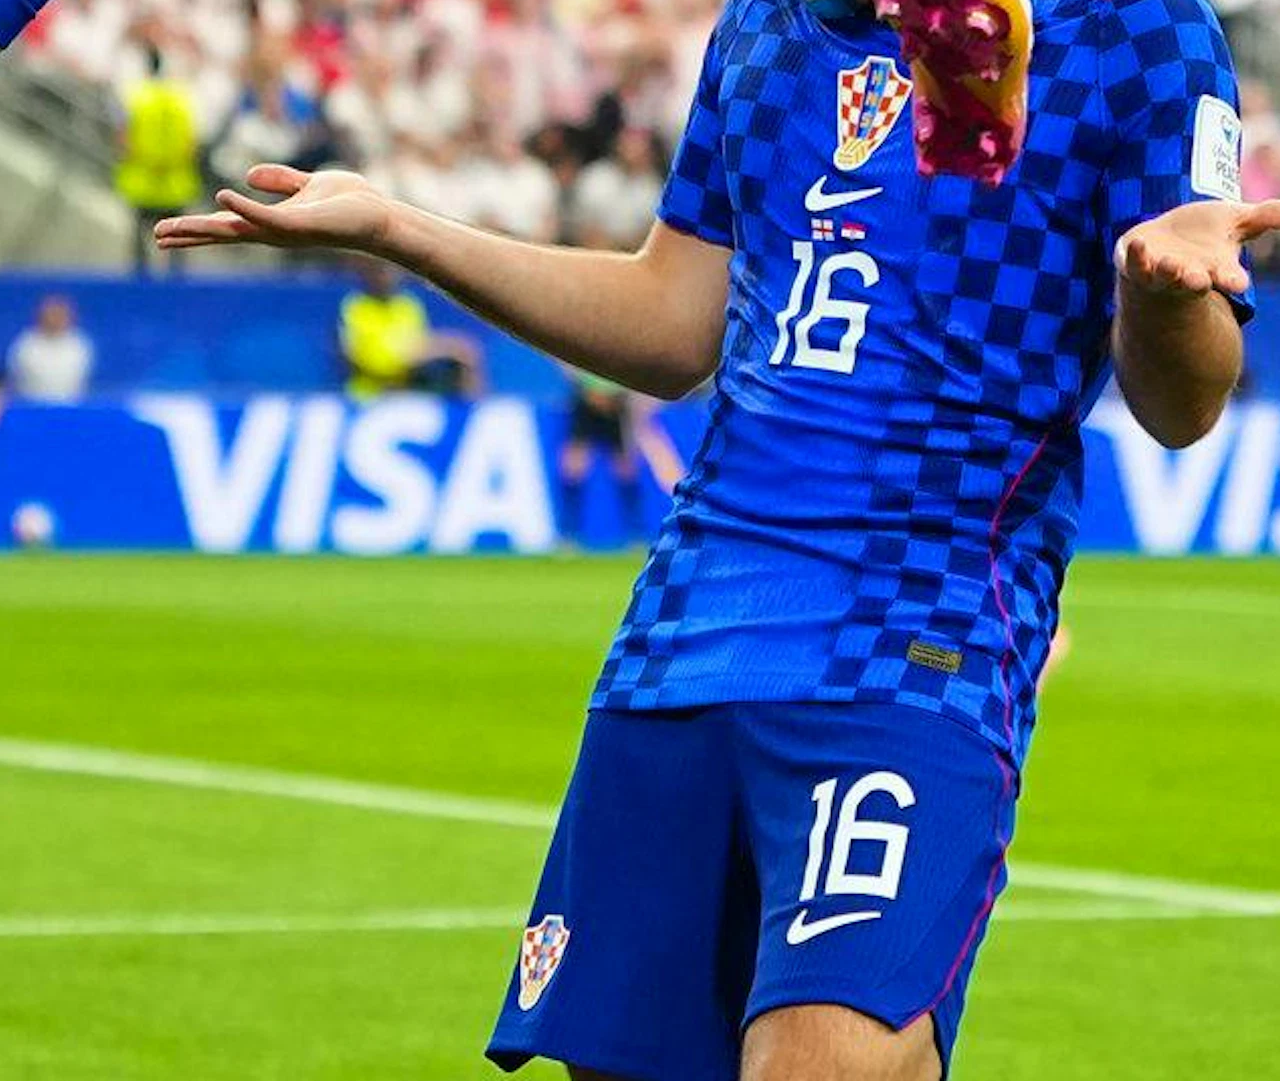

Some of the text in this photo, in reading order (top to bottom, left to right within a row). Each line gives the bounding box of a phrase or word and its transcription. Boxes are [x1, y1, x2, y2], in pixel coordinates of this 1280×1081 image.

[768, 240, 881, 374] 16
[132, 394, 557, 556] VISA
[798, 771, 917, 902] 16
